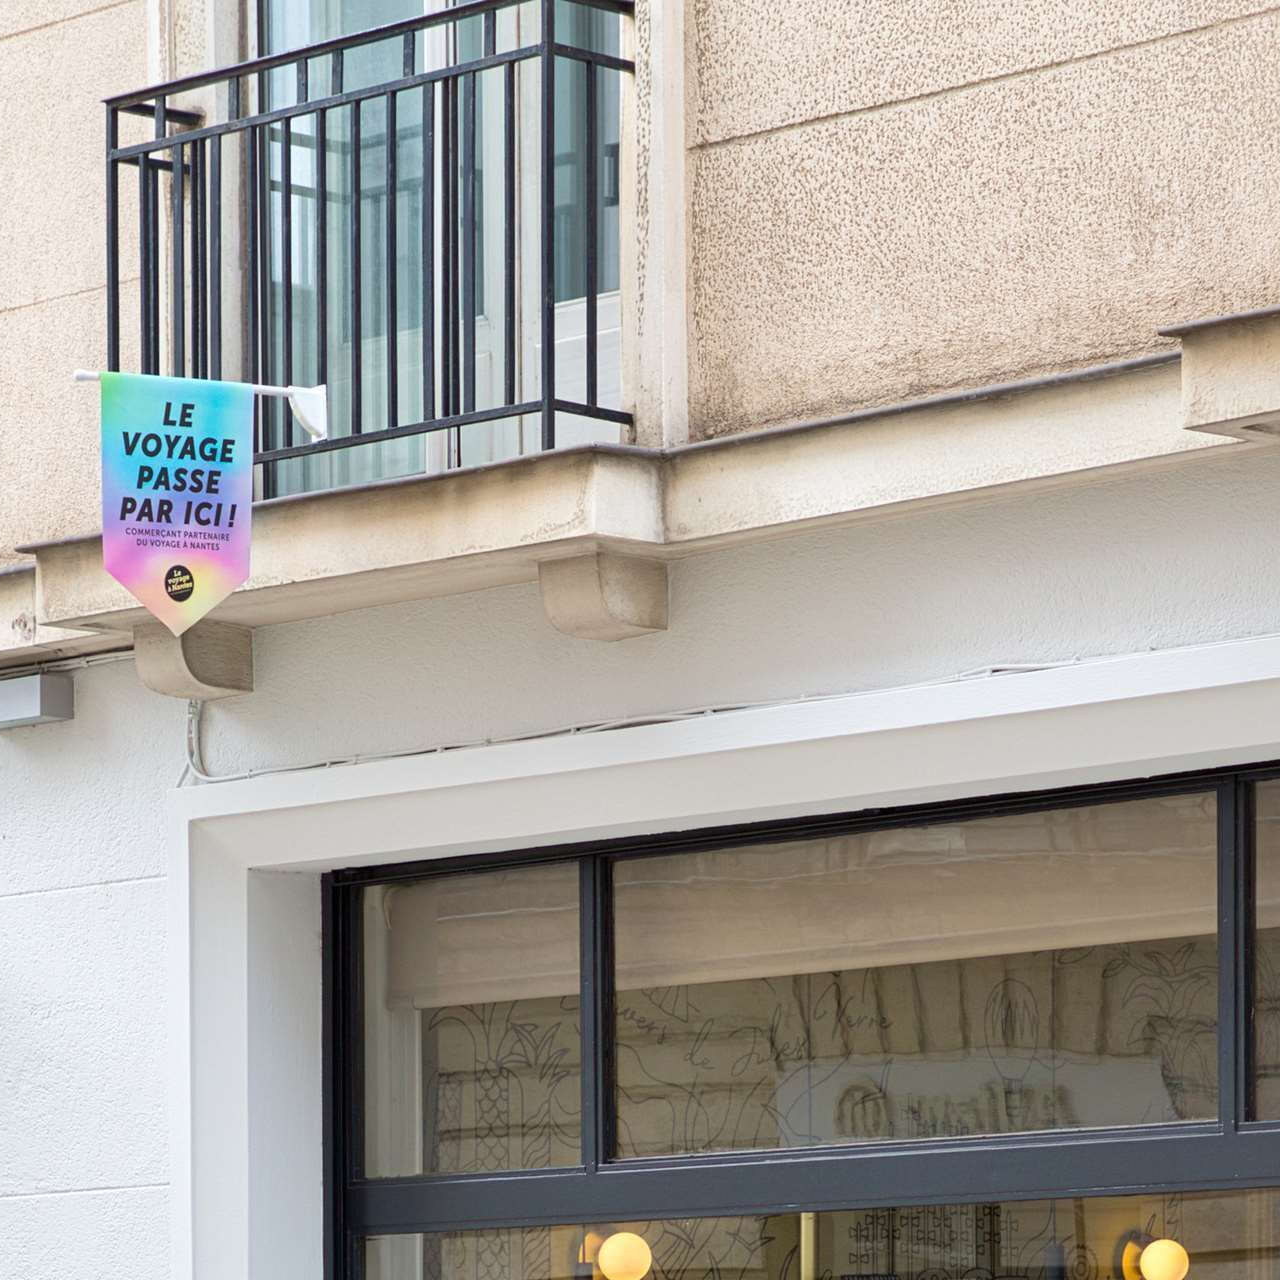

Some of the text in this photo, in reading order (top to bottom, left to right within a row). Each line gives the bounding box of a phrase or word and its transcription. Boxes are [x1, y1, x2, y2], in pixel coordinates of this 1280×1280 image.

[163, 402, 195, 427] LE
[122, 431, 235, 463] VOYAGE
[136, 465, 222, 494] PASSE
[120, 497, 173, 524] PAR
[125, 528, 230, 541] COMMERÇANT PARTENAIRE
[150, 539, 180, 548] VOYAGE
[190, 542, 220, 551] NANTES
